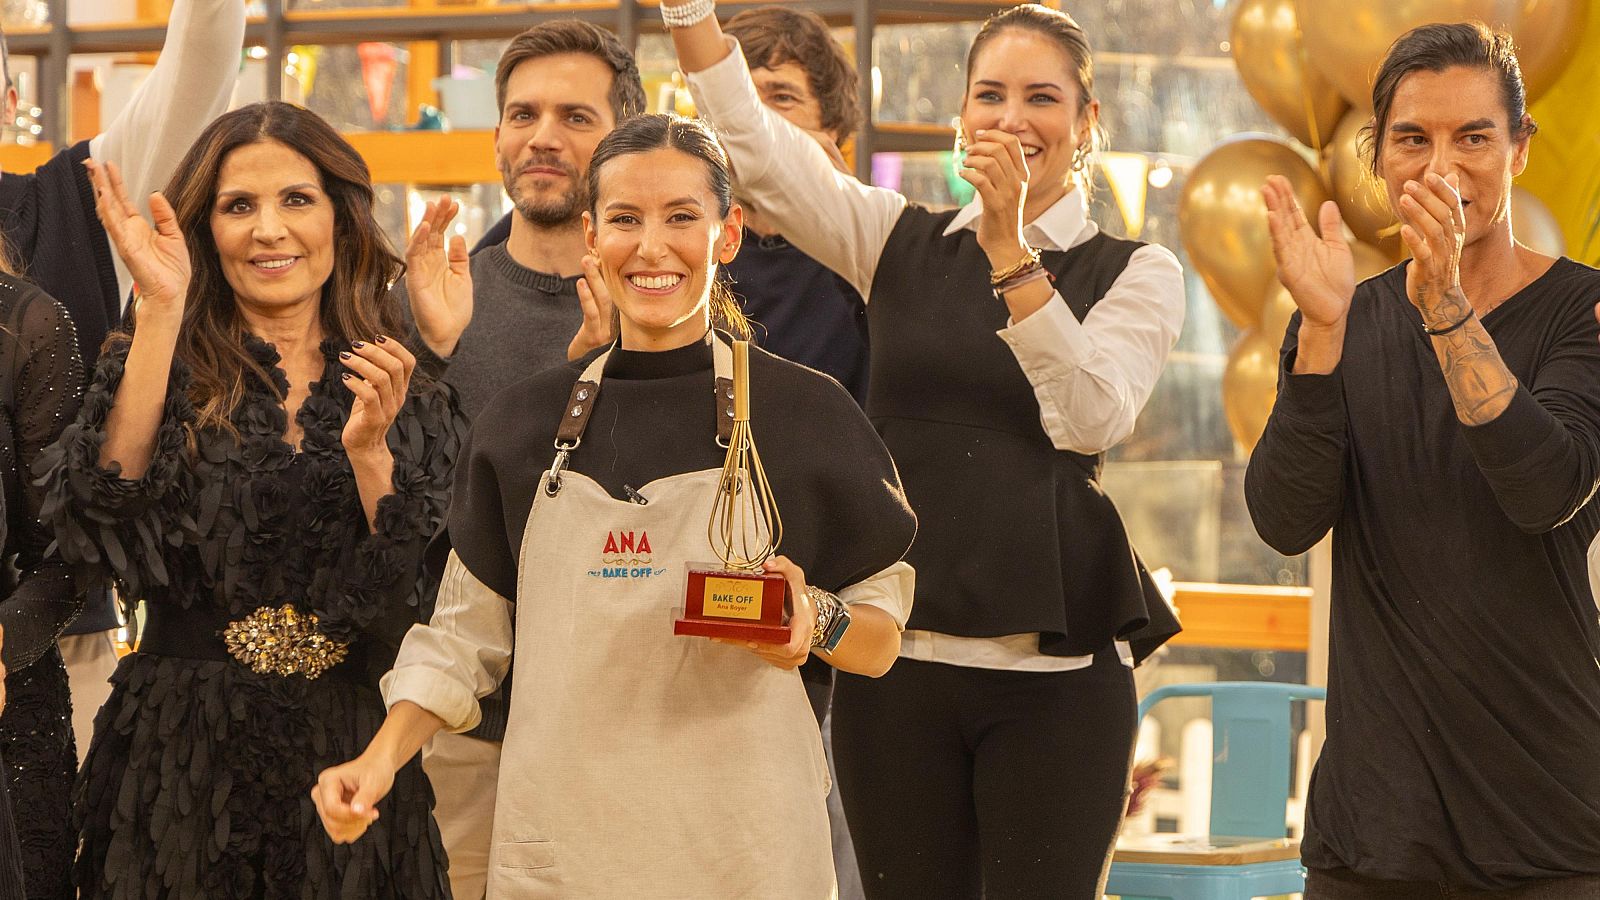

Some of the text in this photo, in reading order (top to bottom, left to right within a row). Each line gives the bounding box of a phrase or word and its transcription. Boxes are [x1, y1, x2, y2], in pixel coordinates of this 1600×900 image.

[603, 531, 652, 553] ANA
[602, 568, 652, 577] BAKE OFF
[712, 594, 753, 604] BAKE OFF
